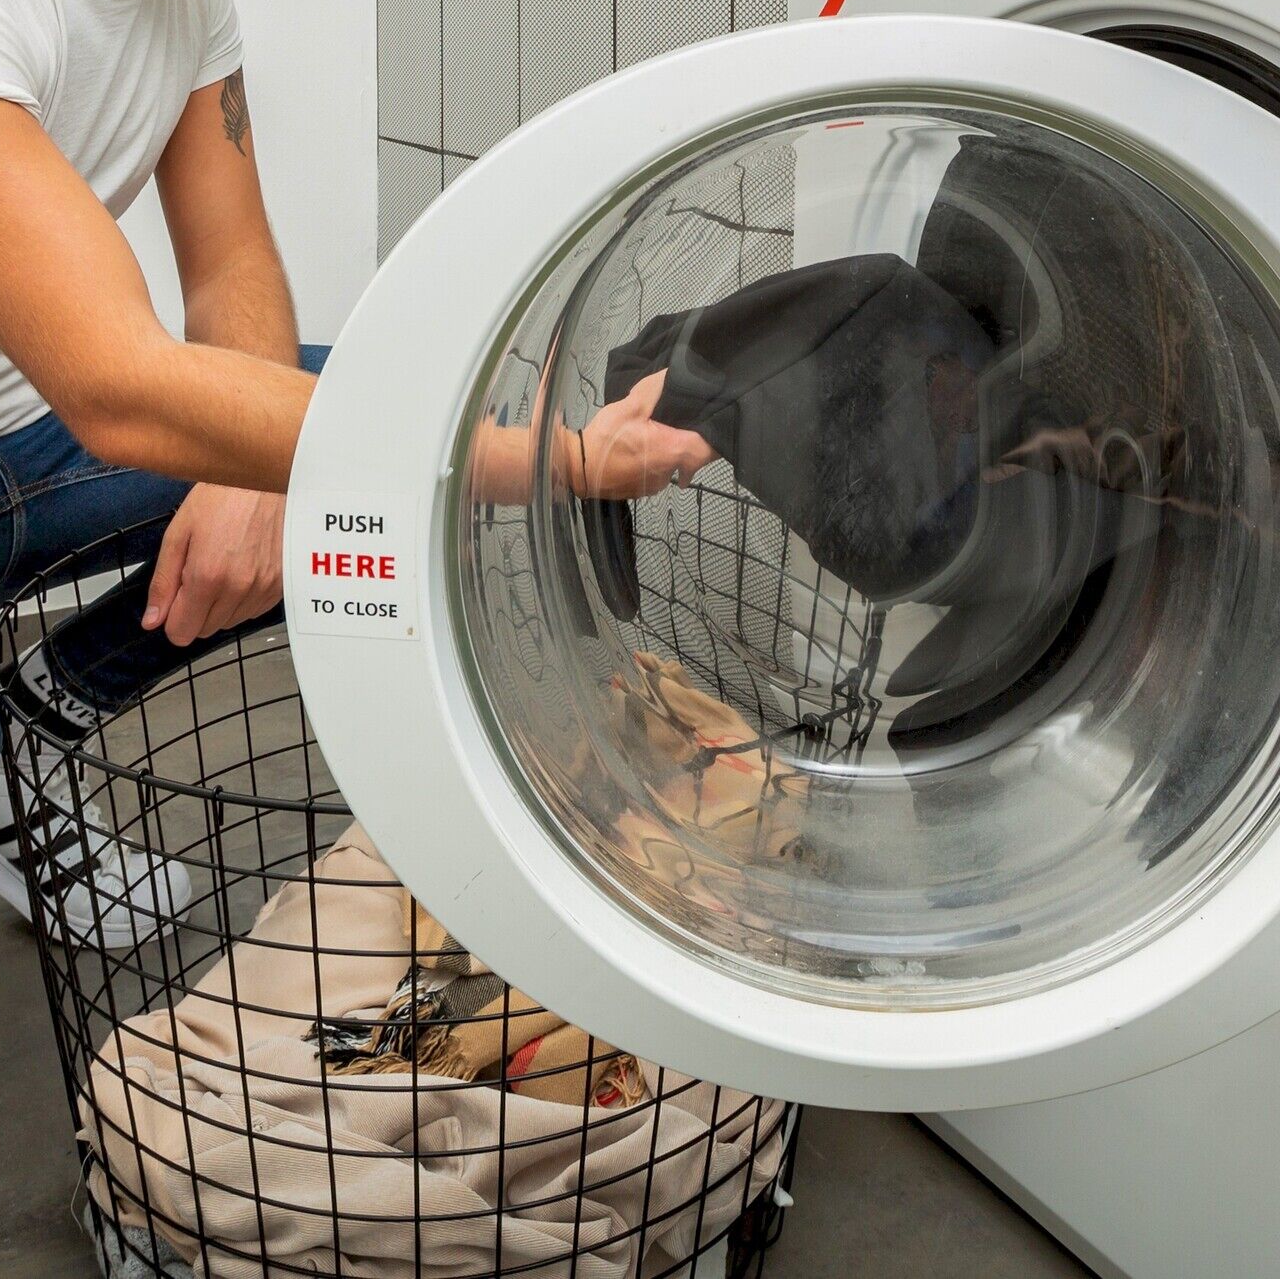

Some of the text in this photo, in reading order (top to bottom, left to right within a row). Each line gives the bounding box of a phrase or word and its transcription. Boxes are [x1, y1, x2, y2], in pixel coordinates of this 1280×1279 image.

[325, 513, 384, 534] PUSH
[312, 552, 396, 580] HERE
[311, 599, 398, 618] TO CLOSE
